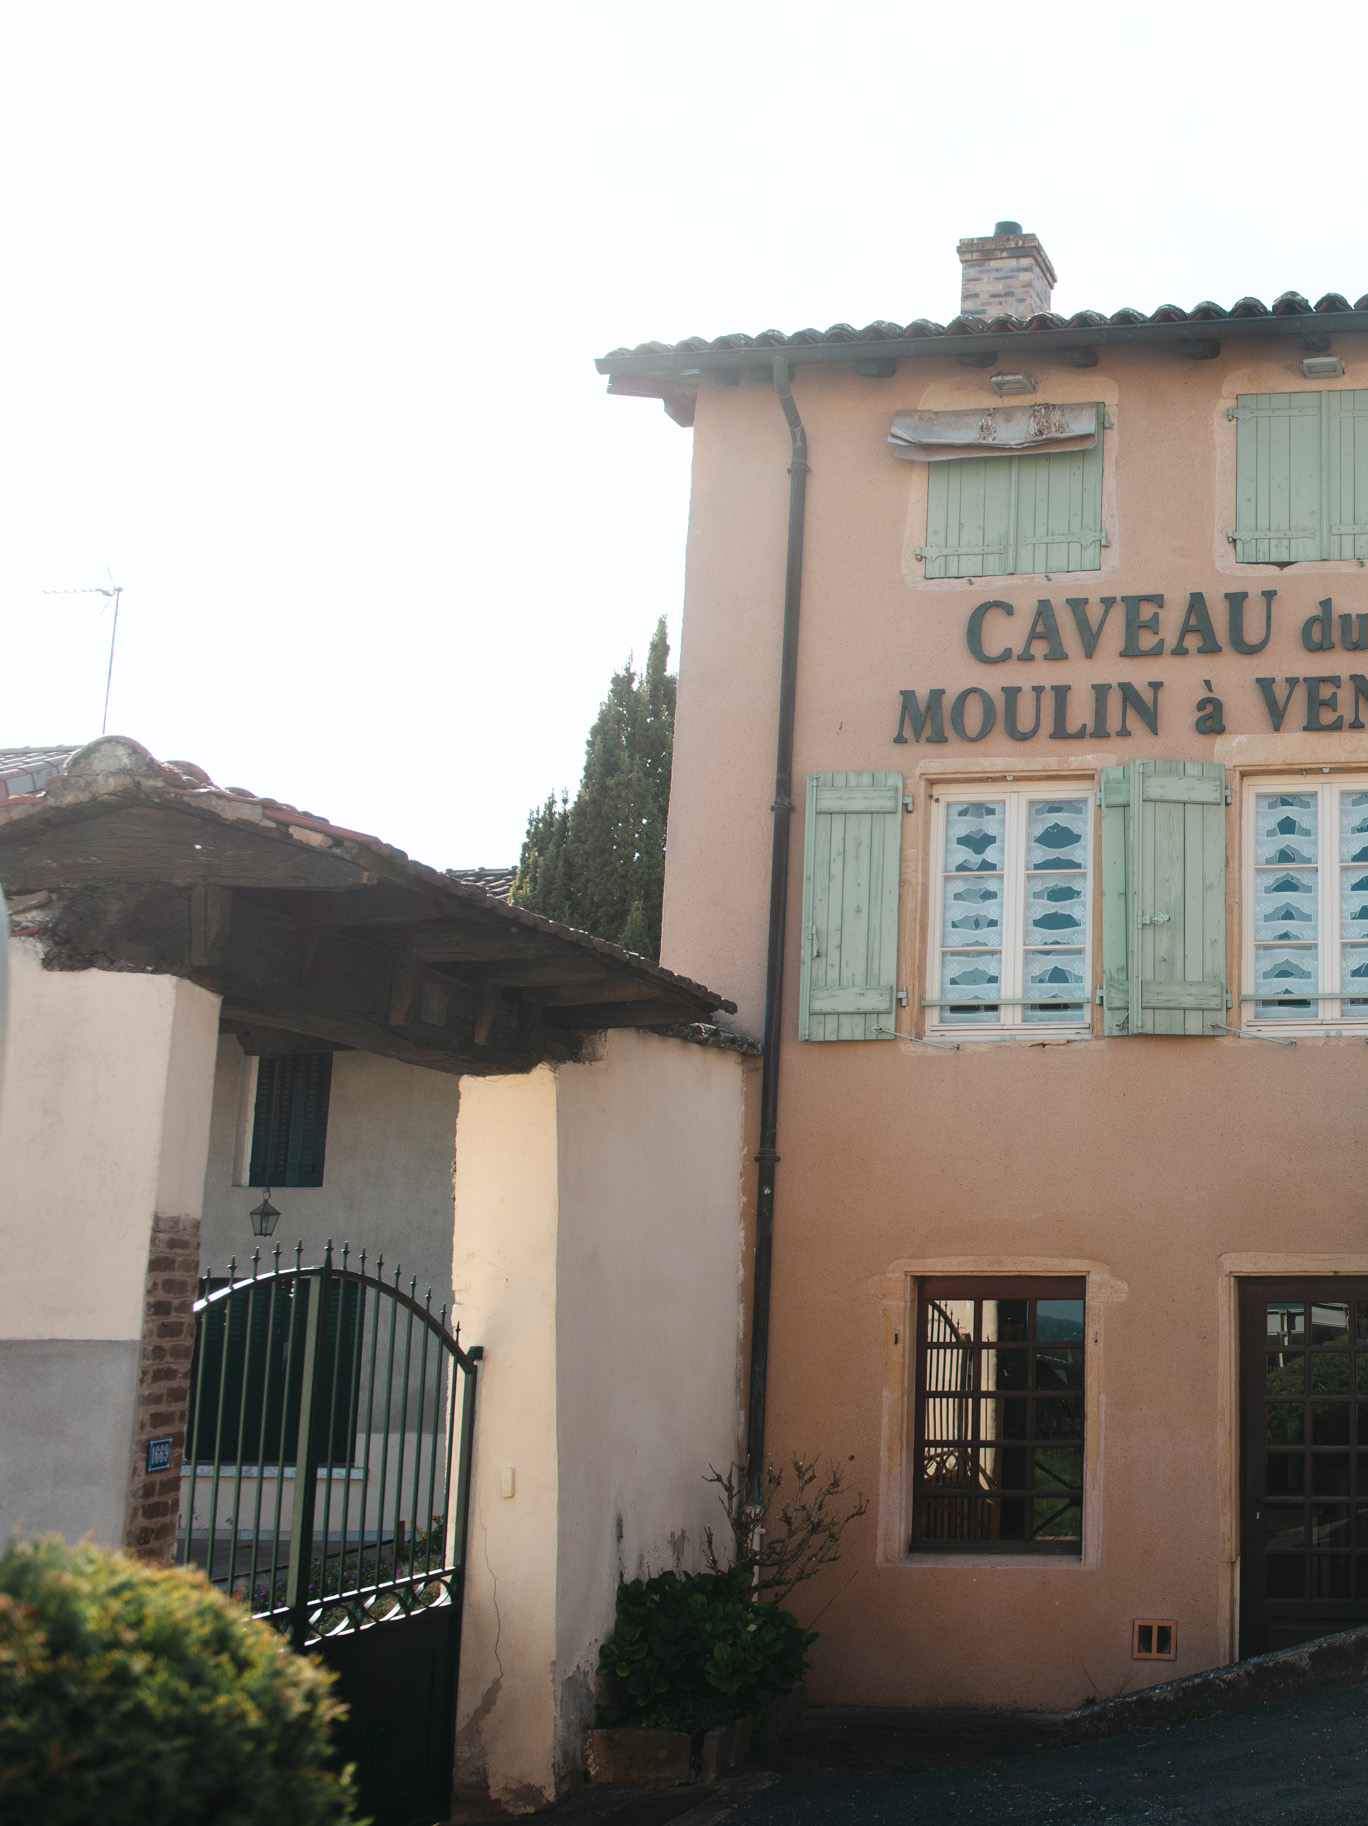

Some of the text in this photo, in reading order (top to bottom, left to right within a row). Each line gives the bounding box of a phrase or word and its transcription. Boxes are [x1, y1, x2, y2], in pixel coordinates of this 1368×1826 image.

[966, 590, 1278, 664] CAVEAU
[892, 681, 1164, 744] MOULIN
[1195, 679, 1226, 735] à
